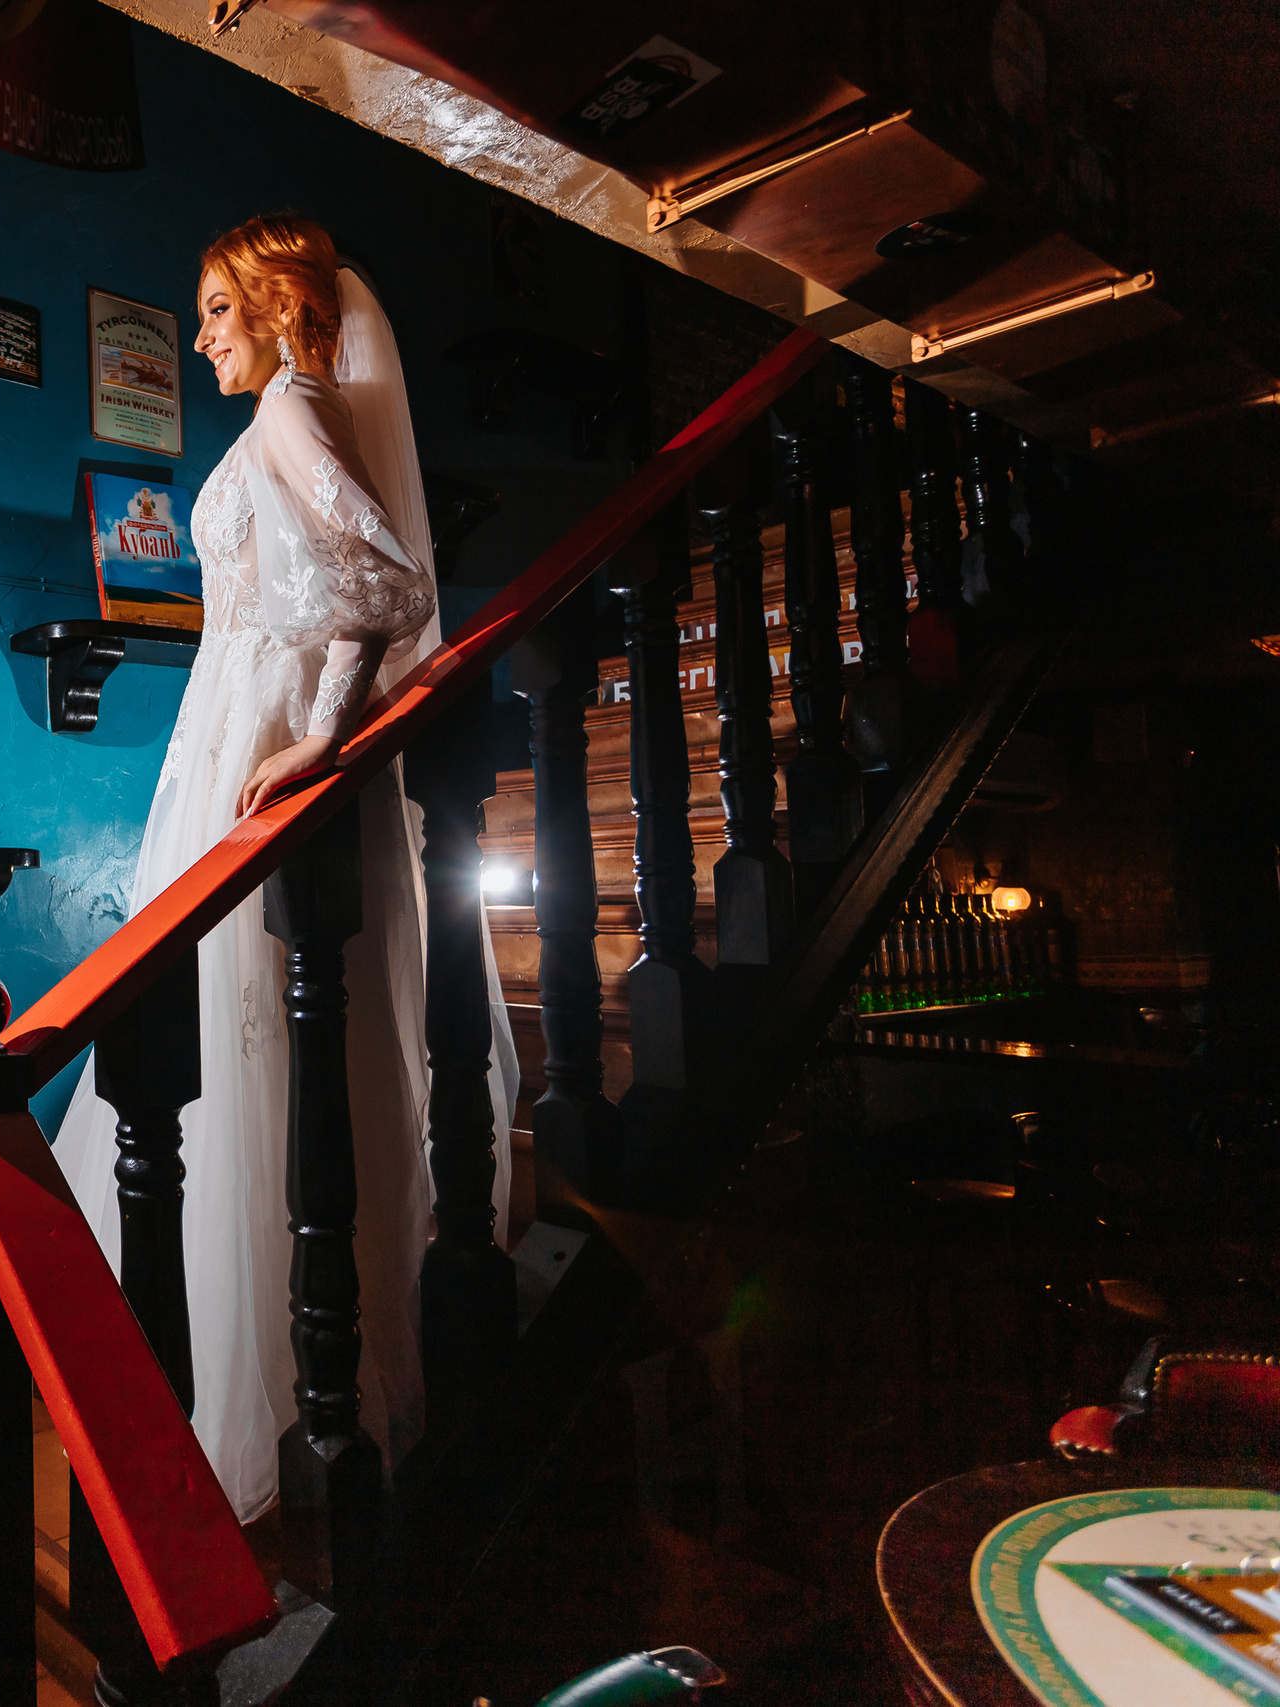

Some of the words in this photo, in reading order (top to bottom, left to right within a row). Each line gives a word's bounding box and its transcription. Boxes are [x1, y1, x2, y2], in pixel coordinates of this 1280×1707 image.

[54, 109, 132, 166] ЗДОРОВЬЮ
[96, 315, 174, 353] TYRCONNELL
[105, 337, 143, 351] SINGLE
[146, 348, 171, 360] MALT
[118, 525, 181, 560] Кубань
